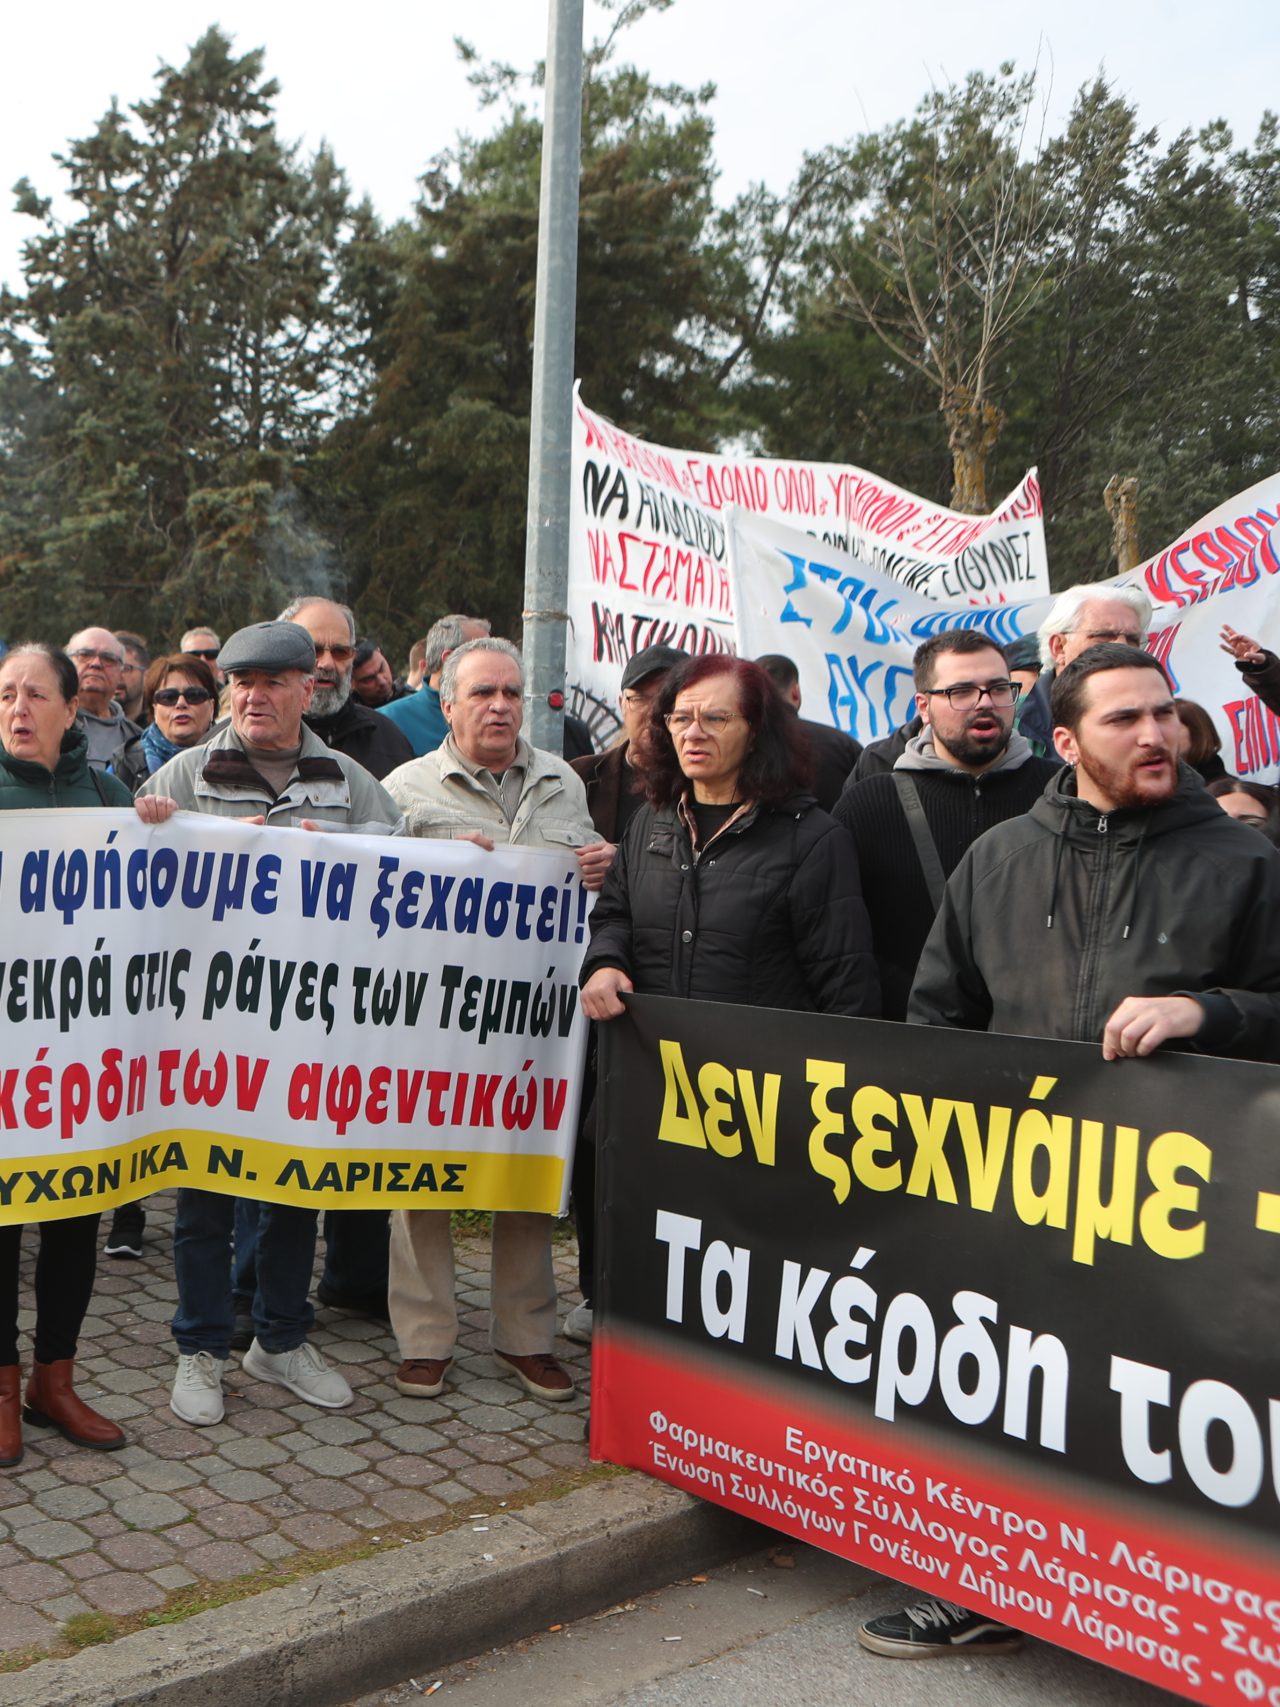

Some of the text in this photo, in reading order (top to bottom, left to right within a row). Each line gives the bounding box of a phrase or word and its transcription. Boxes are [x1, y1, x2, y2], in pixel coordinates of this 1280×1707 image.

[583, 460, 629, 520] ΝΑ
[588, 528, 617, 585] ΝΑ
[618, 532, 734, 616] ΣΤΑΜΑΤΗ
[19, 829, 282, 925] αφήσουμε
[299, 858, 358, 923] να
[368, 855, 589, 945] ξεχαστεί!
[125, 948, 191, 1020] στις
[204, 938, 338, 1035] ράγες
[351, 964, 424, 1029] των
[439, 964, 578, 1044] Τεμπών
[157, 1047, 271, 1113] των
[287, 1059, 568, 1135] αφεντικών
[130, 1141, 189, 1185] ΙΚΑ
[274, 1158, 468, 1193] ΛΑΡΙΣΑΣ
[658, 1039, 782, 1167] Δεν
[805, 1057, 1212, 1266] ξεχνάμε
[655, 1208, 1280, 1509] Τα κέρδη το
[648, 1410, 846, 1510] Φαρμακευτικός
[853, 1487, 1009, 1572] Σύλλογος
[1018, 1547, 1180, 1636] Λάρισας
[785, 1426, 916, 1496] Εργατικό
[925, 1477, 1047, 1541] Κέντρο
[648, 1439, 726, 1496] Ένωση
[729, 1474, 846, 1538] Συλλόγων
[853, 1520, 951, 1580] Γονέων
[958, 1562, 1053, 1620] Δήμου
[1061, 1601, 1202, 1686] Λάρισας
